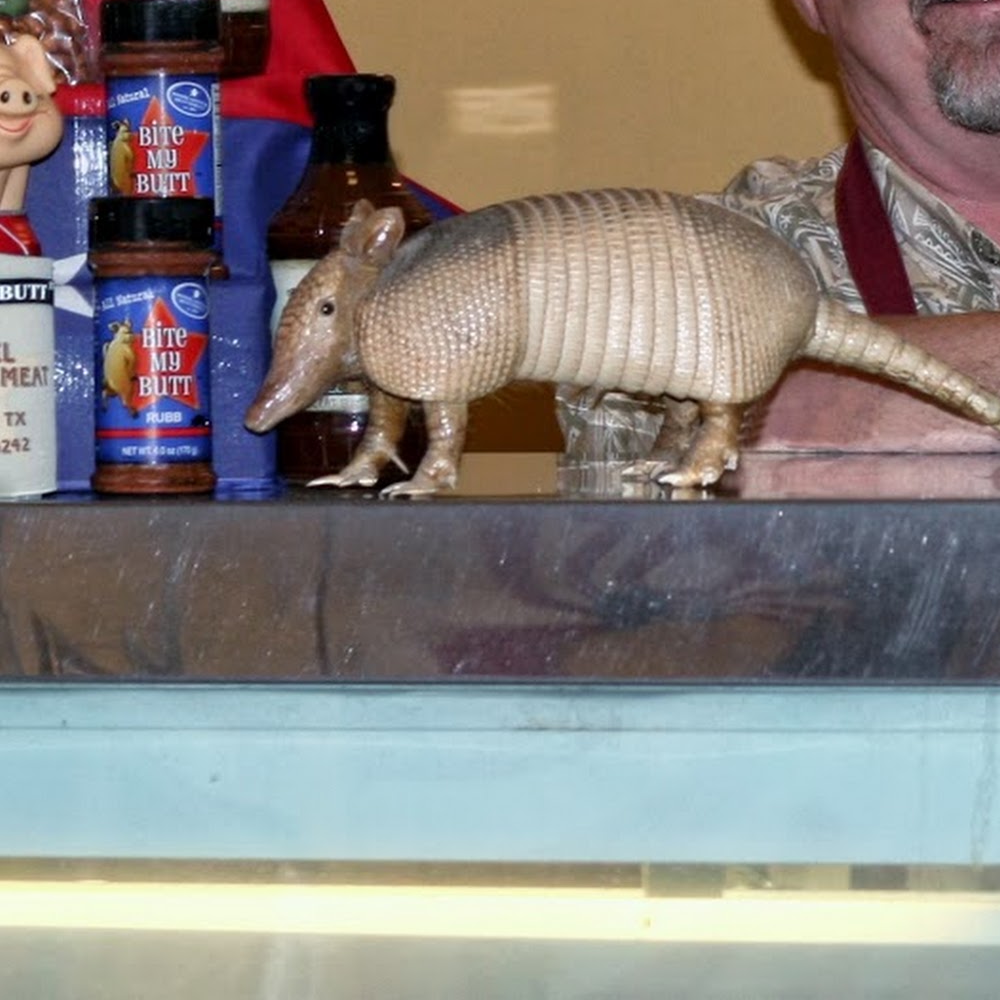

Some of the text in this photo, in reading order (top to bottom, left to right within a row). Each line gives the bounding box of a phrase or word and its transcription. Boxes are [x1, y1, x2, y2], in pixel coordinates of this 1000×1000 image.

[137, 172, 190, 194] BUTT
[0, 284, 47, 301] BUTT
[0, 341, 15, 363] L
[0, 366, 49, 388] MEAT
[138, 375, 192, 397] BUTT
[4, 411, 26, 427] TX
[145, 411, 183, 424] RUBB
[0, 436, 31, 454] 242
